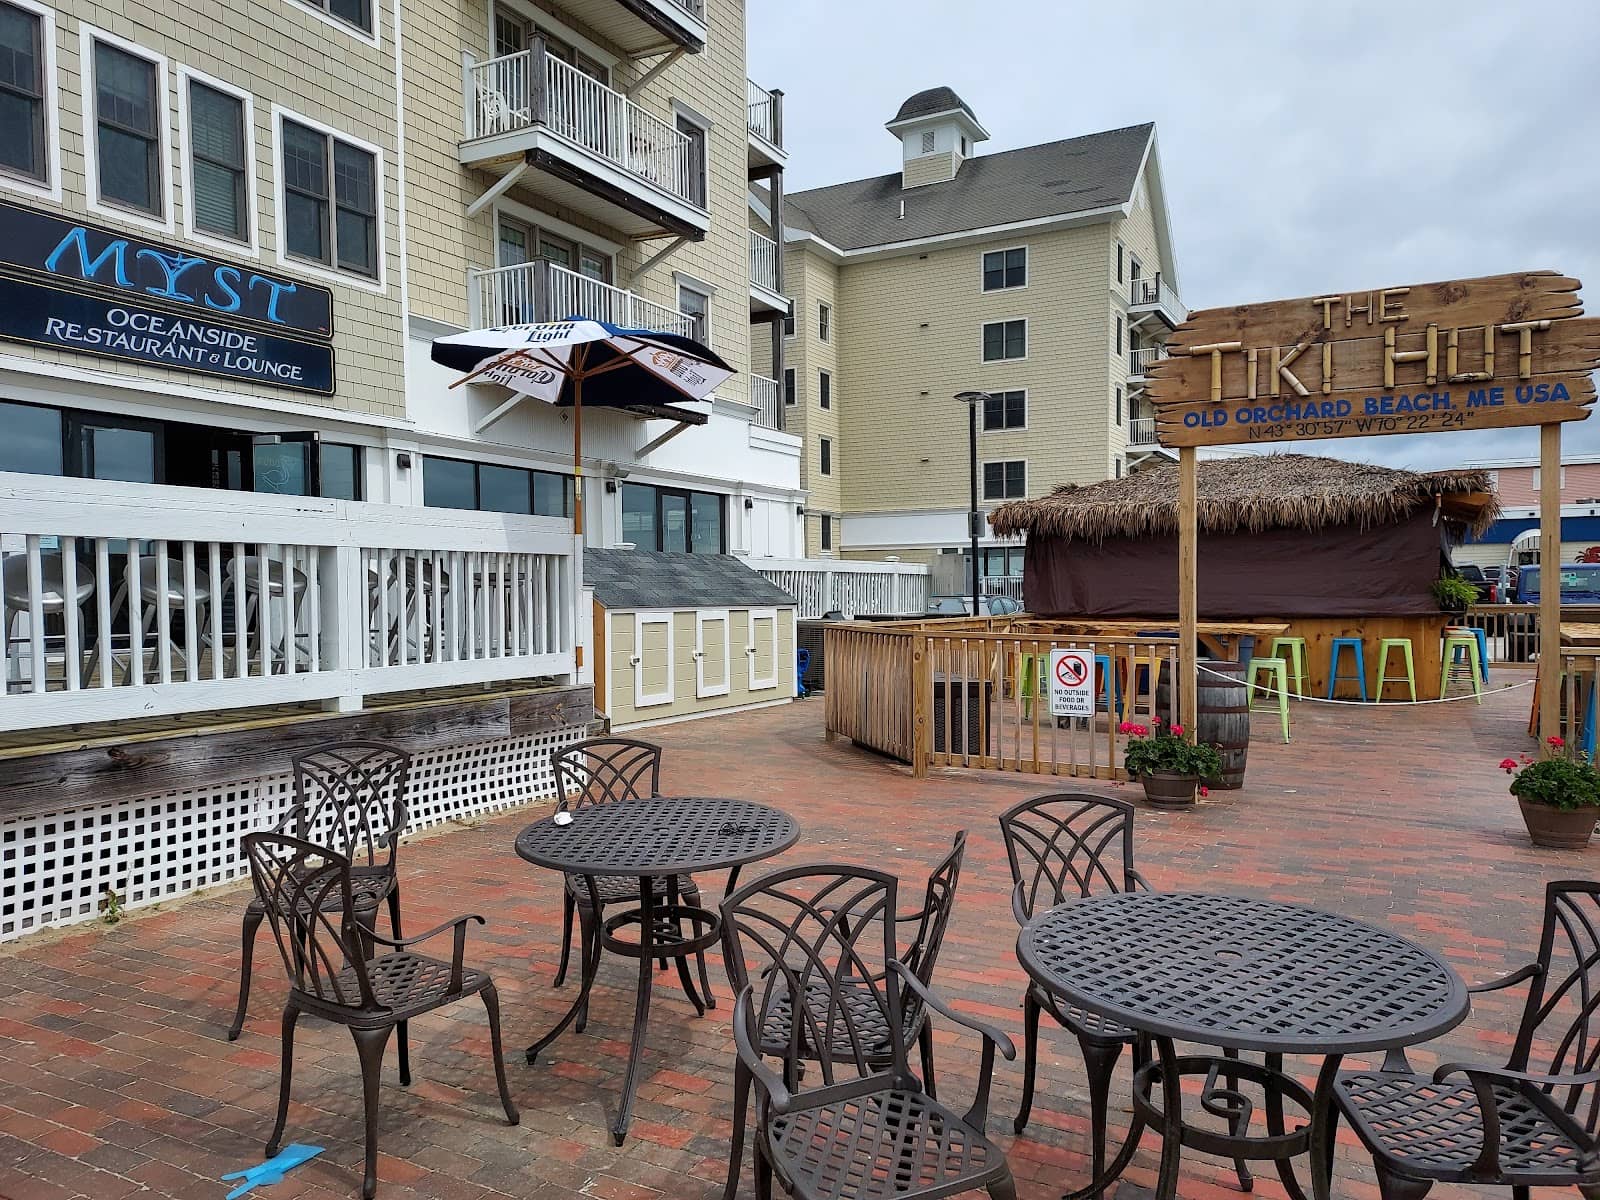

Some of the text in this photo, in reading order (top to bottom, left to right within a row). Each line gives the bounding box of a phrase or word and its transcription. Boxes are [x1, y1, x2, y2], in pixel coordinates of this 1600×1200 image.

[45, 227, 297, 324] MYST
[106, 308, 258, 354] OCEANSIDE
[1313, 288, 1410, 329] THE
[45, 317, 304, 381] RESTAURANT & LOUNGE
[525, 329, 571, 343] Light
[1189, 319, 1552, 402] TIKI HUT
[1183, 409, 1228, 428] OLD
[1235, 399, 1352, 424] ORCHARD
[1466, 387, 1505, 408] ME
[1515, 382, 1571, 404] USA
